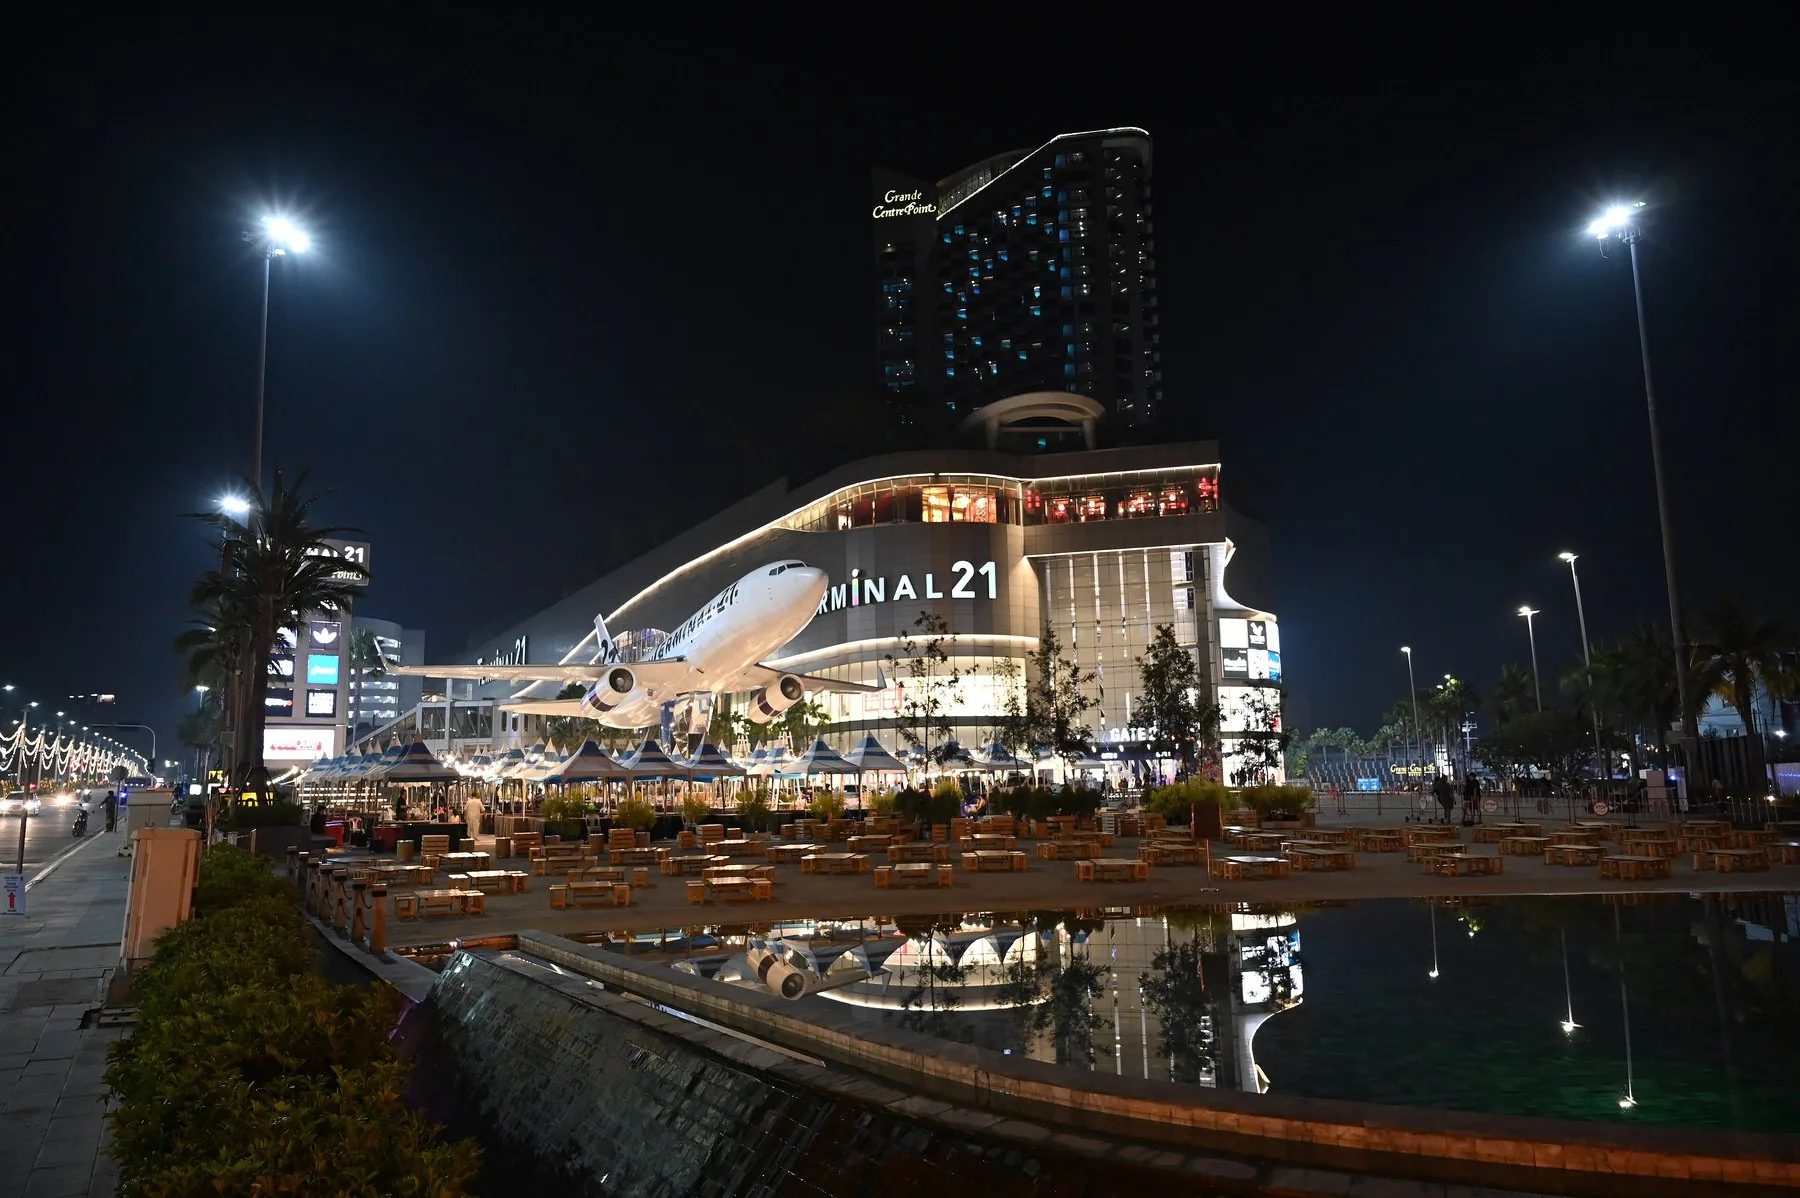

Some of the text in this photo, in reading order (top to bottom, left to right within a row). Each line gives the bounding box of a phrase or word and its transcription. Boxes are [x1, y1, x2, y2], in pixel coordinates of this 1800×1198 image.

[885, 190, 922, 203] Grande
[344, 546, 364, 562] 21
[818, 560, 997, 615] RMiNAL 21
[1109, 727, 1147, 742] GATE
